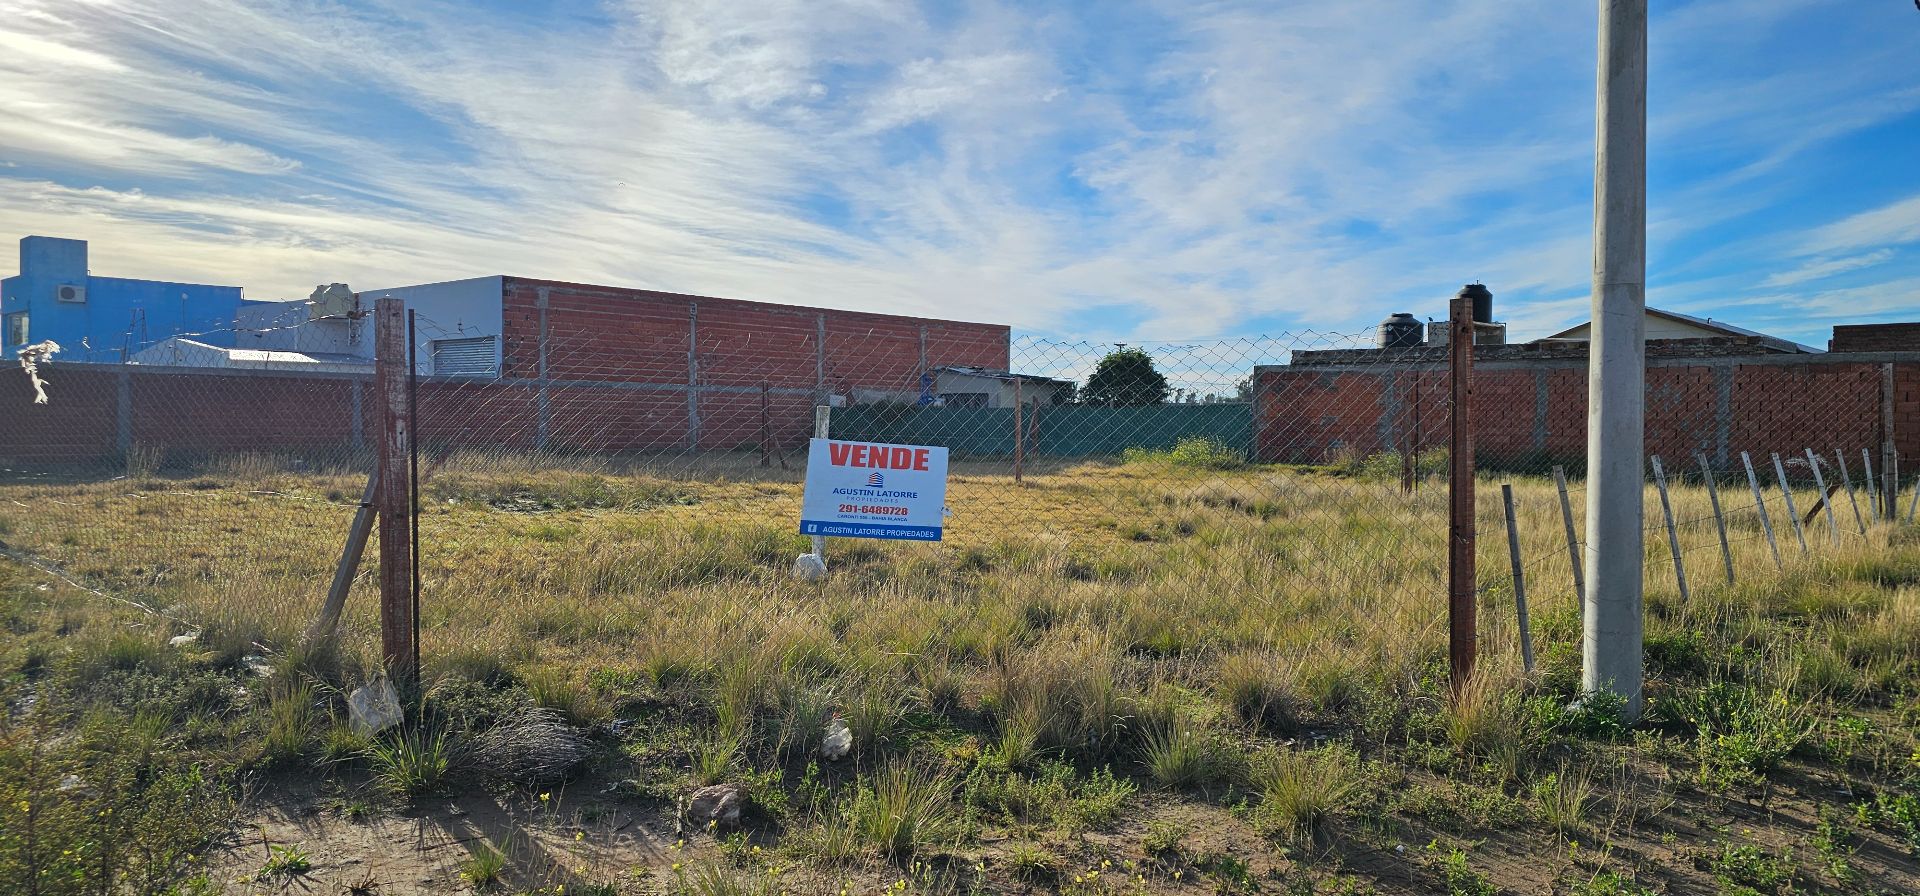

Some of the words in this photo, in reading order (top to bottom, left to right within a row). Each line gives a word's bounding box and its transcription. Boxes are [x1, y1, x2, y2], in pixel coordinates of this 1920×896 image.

[829, 443, 929, 471] VENDE
[833, 488, 874, 496] AGUSTIN
[877, 490, 918, 499] LATORRE
[839, 504, 908, 516] 291-6489728
[822, 526, 852, 534] AGUSTIN
[854, 527, 885, 536] LATORRE
[886, 529, 934, 538] PROPIEDADES
